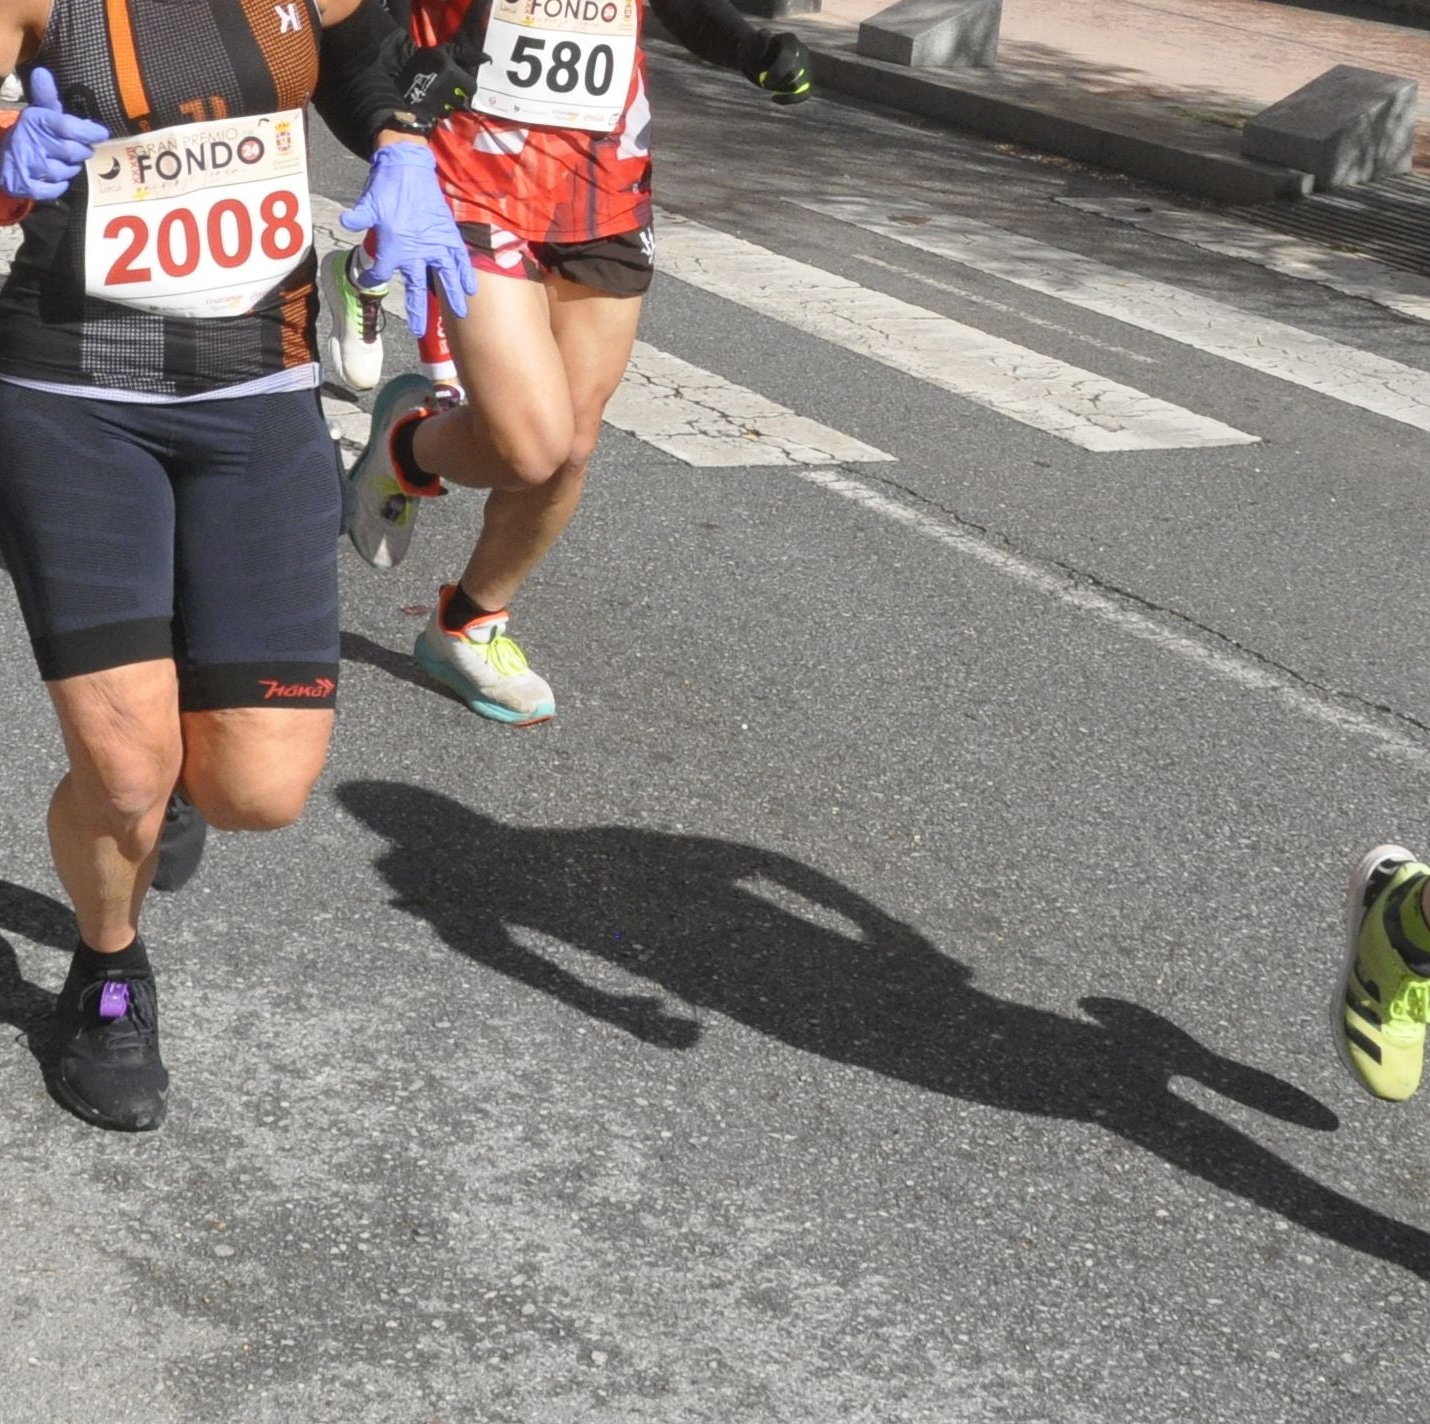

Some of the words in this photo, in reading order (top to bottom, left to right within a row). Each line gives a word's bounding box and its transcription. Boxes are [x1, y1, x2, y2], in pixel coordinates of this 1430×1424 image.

[506, 35, 614, 96] 580
[135, 138, 178, 157] GRAN
[183, 127, 239, 147] PREMIO
[137, 135, 265, 184] FONDO
[103, 189, 304, 286] 2008
